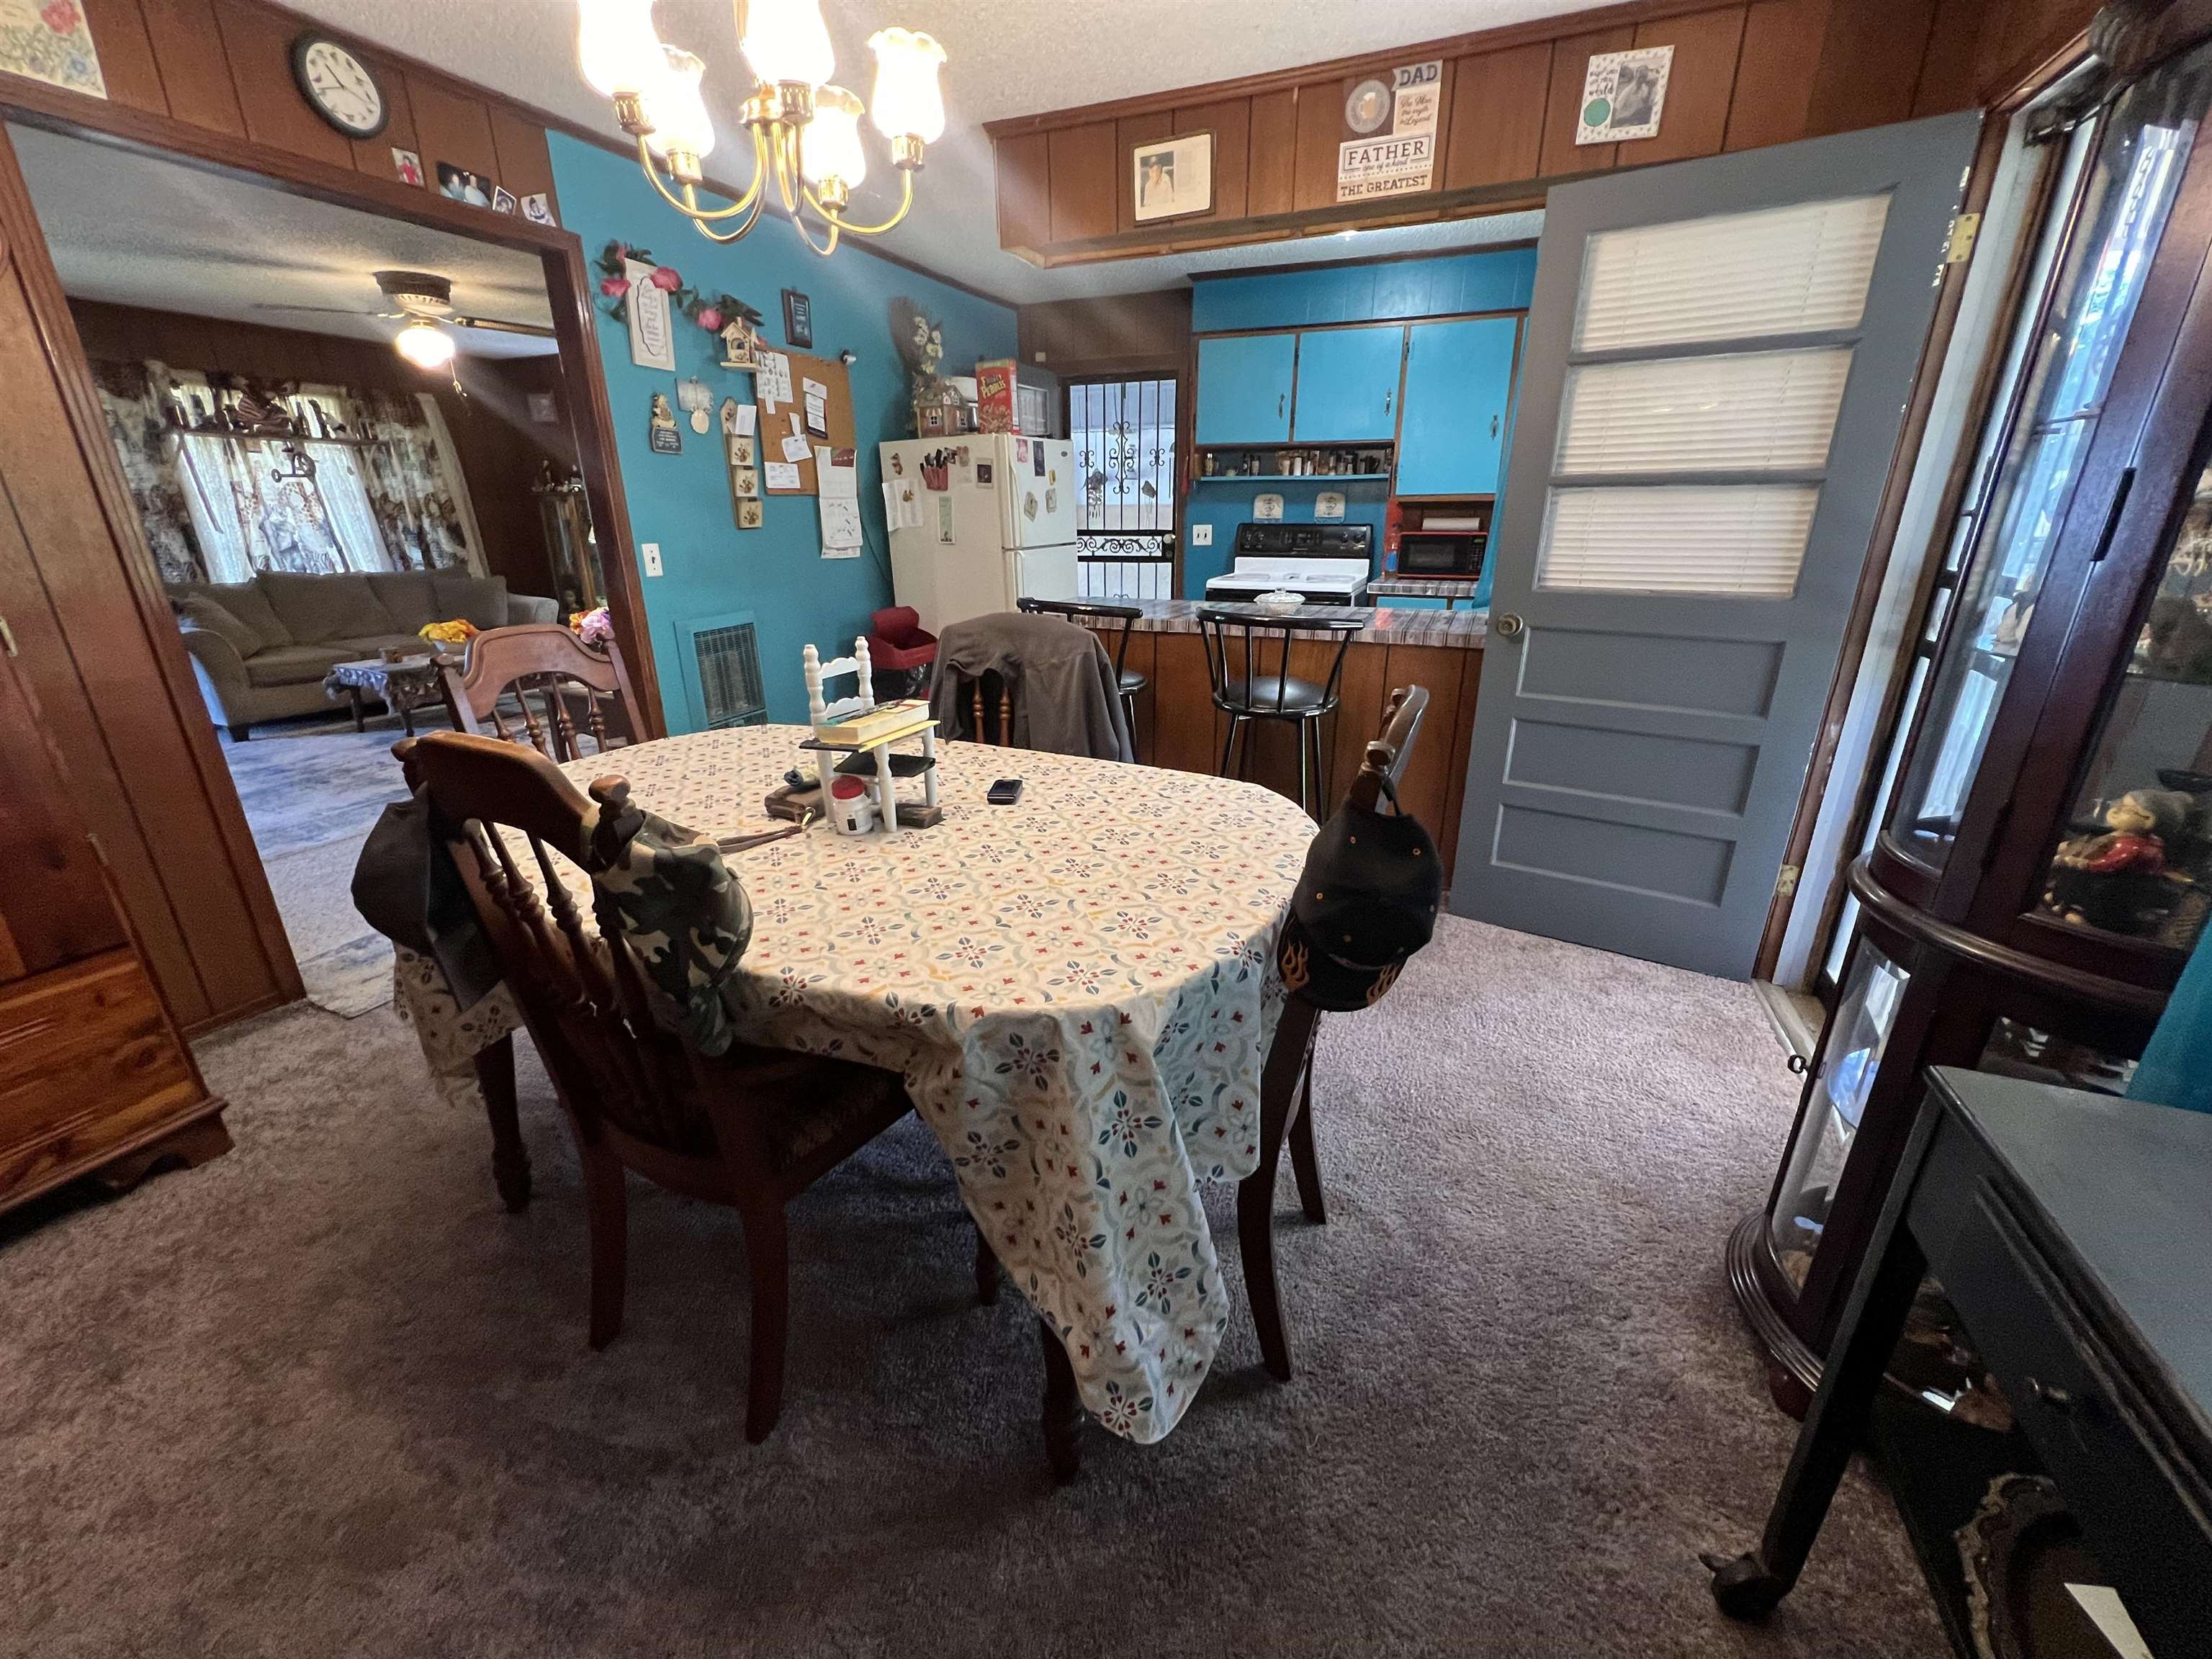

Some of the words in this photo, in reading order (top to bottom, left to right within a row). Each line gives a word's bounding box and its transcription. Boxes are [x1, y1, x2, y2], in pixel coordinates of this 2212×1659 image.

[1399, 65, 1438, 86] DAD
[1348, 140, 1424, 166] FATHER
[1341, 184, 1363, 197] THE
[1367, 174, 1428, 193] GREATEST
